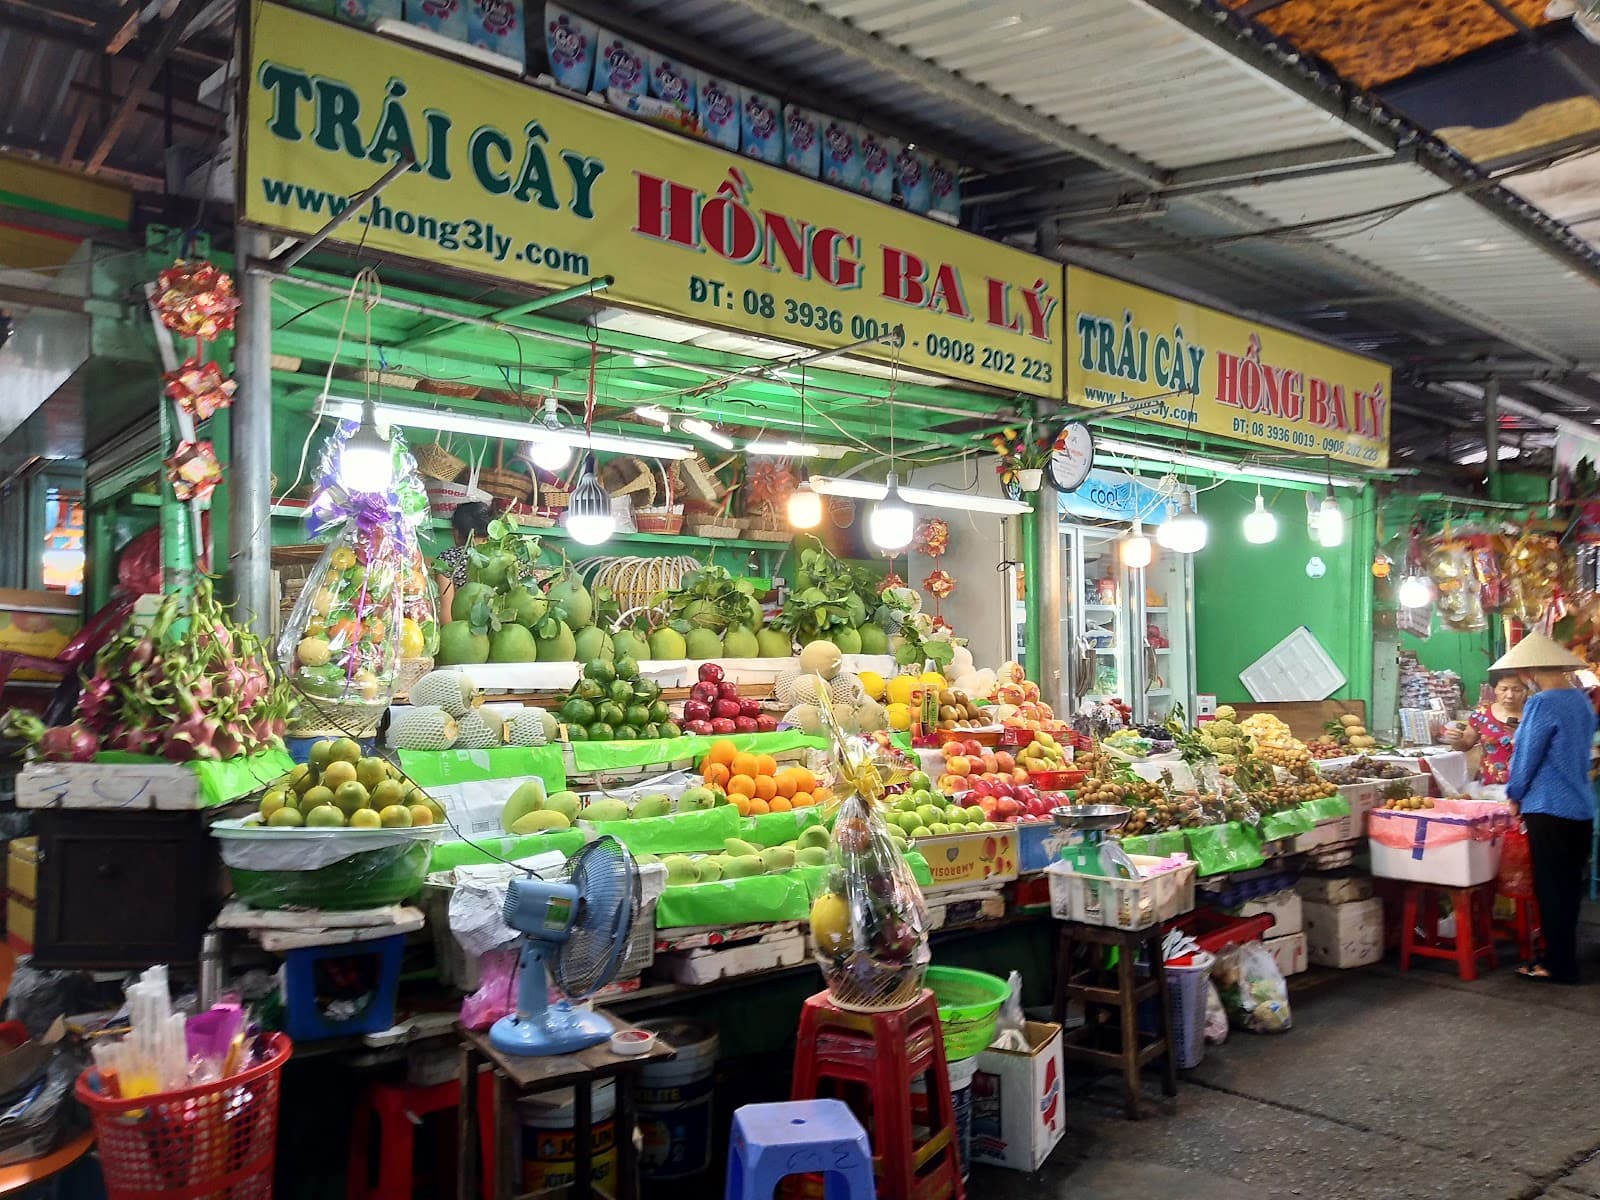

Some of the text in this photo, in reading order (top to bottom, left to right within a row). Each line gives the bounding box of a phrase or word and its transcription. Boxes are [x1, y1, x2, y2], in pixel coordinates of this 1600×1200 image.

[259, 59, 605, 220] TRÁI CÂY
[262, 176, 589, 276] www.hong3ly.com
[631, 166, 1058, 344] HỒNG BA LÝ
[689, 275, 733, 309] ĐT:
[743, 287, 776, 319] 08
[784, 298, 843, 334] 3936
[926, 333, 975, 364] 0908
[982, 348, 1015, 375] 202
[1021, 356, 1053, 383] 223
[1077, 308, 1205, 395] TRÁI CÂY
[1215, 332, 1386, 442] HỒNG BA LÝ
[1232, 417, 1249, 434] ĐT:
[1252, 422, 1264, 436] 08
[1267, 425, 1290, 442] 3936
[1292, 431, 1315, 447] 0019
[1322, 438, 1344, 453] 0908
